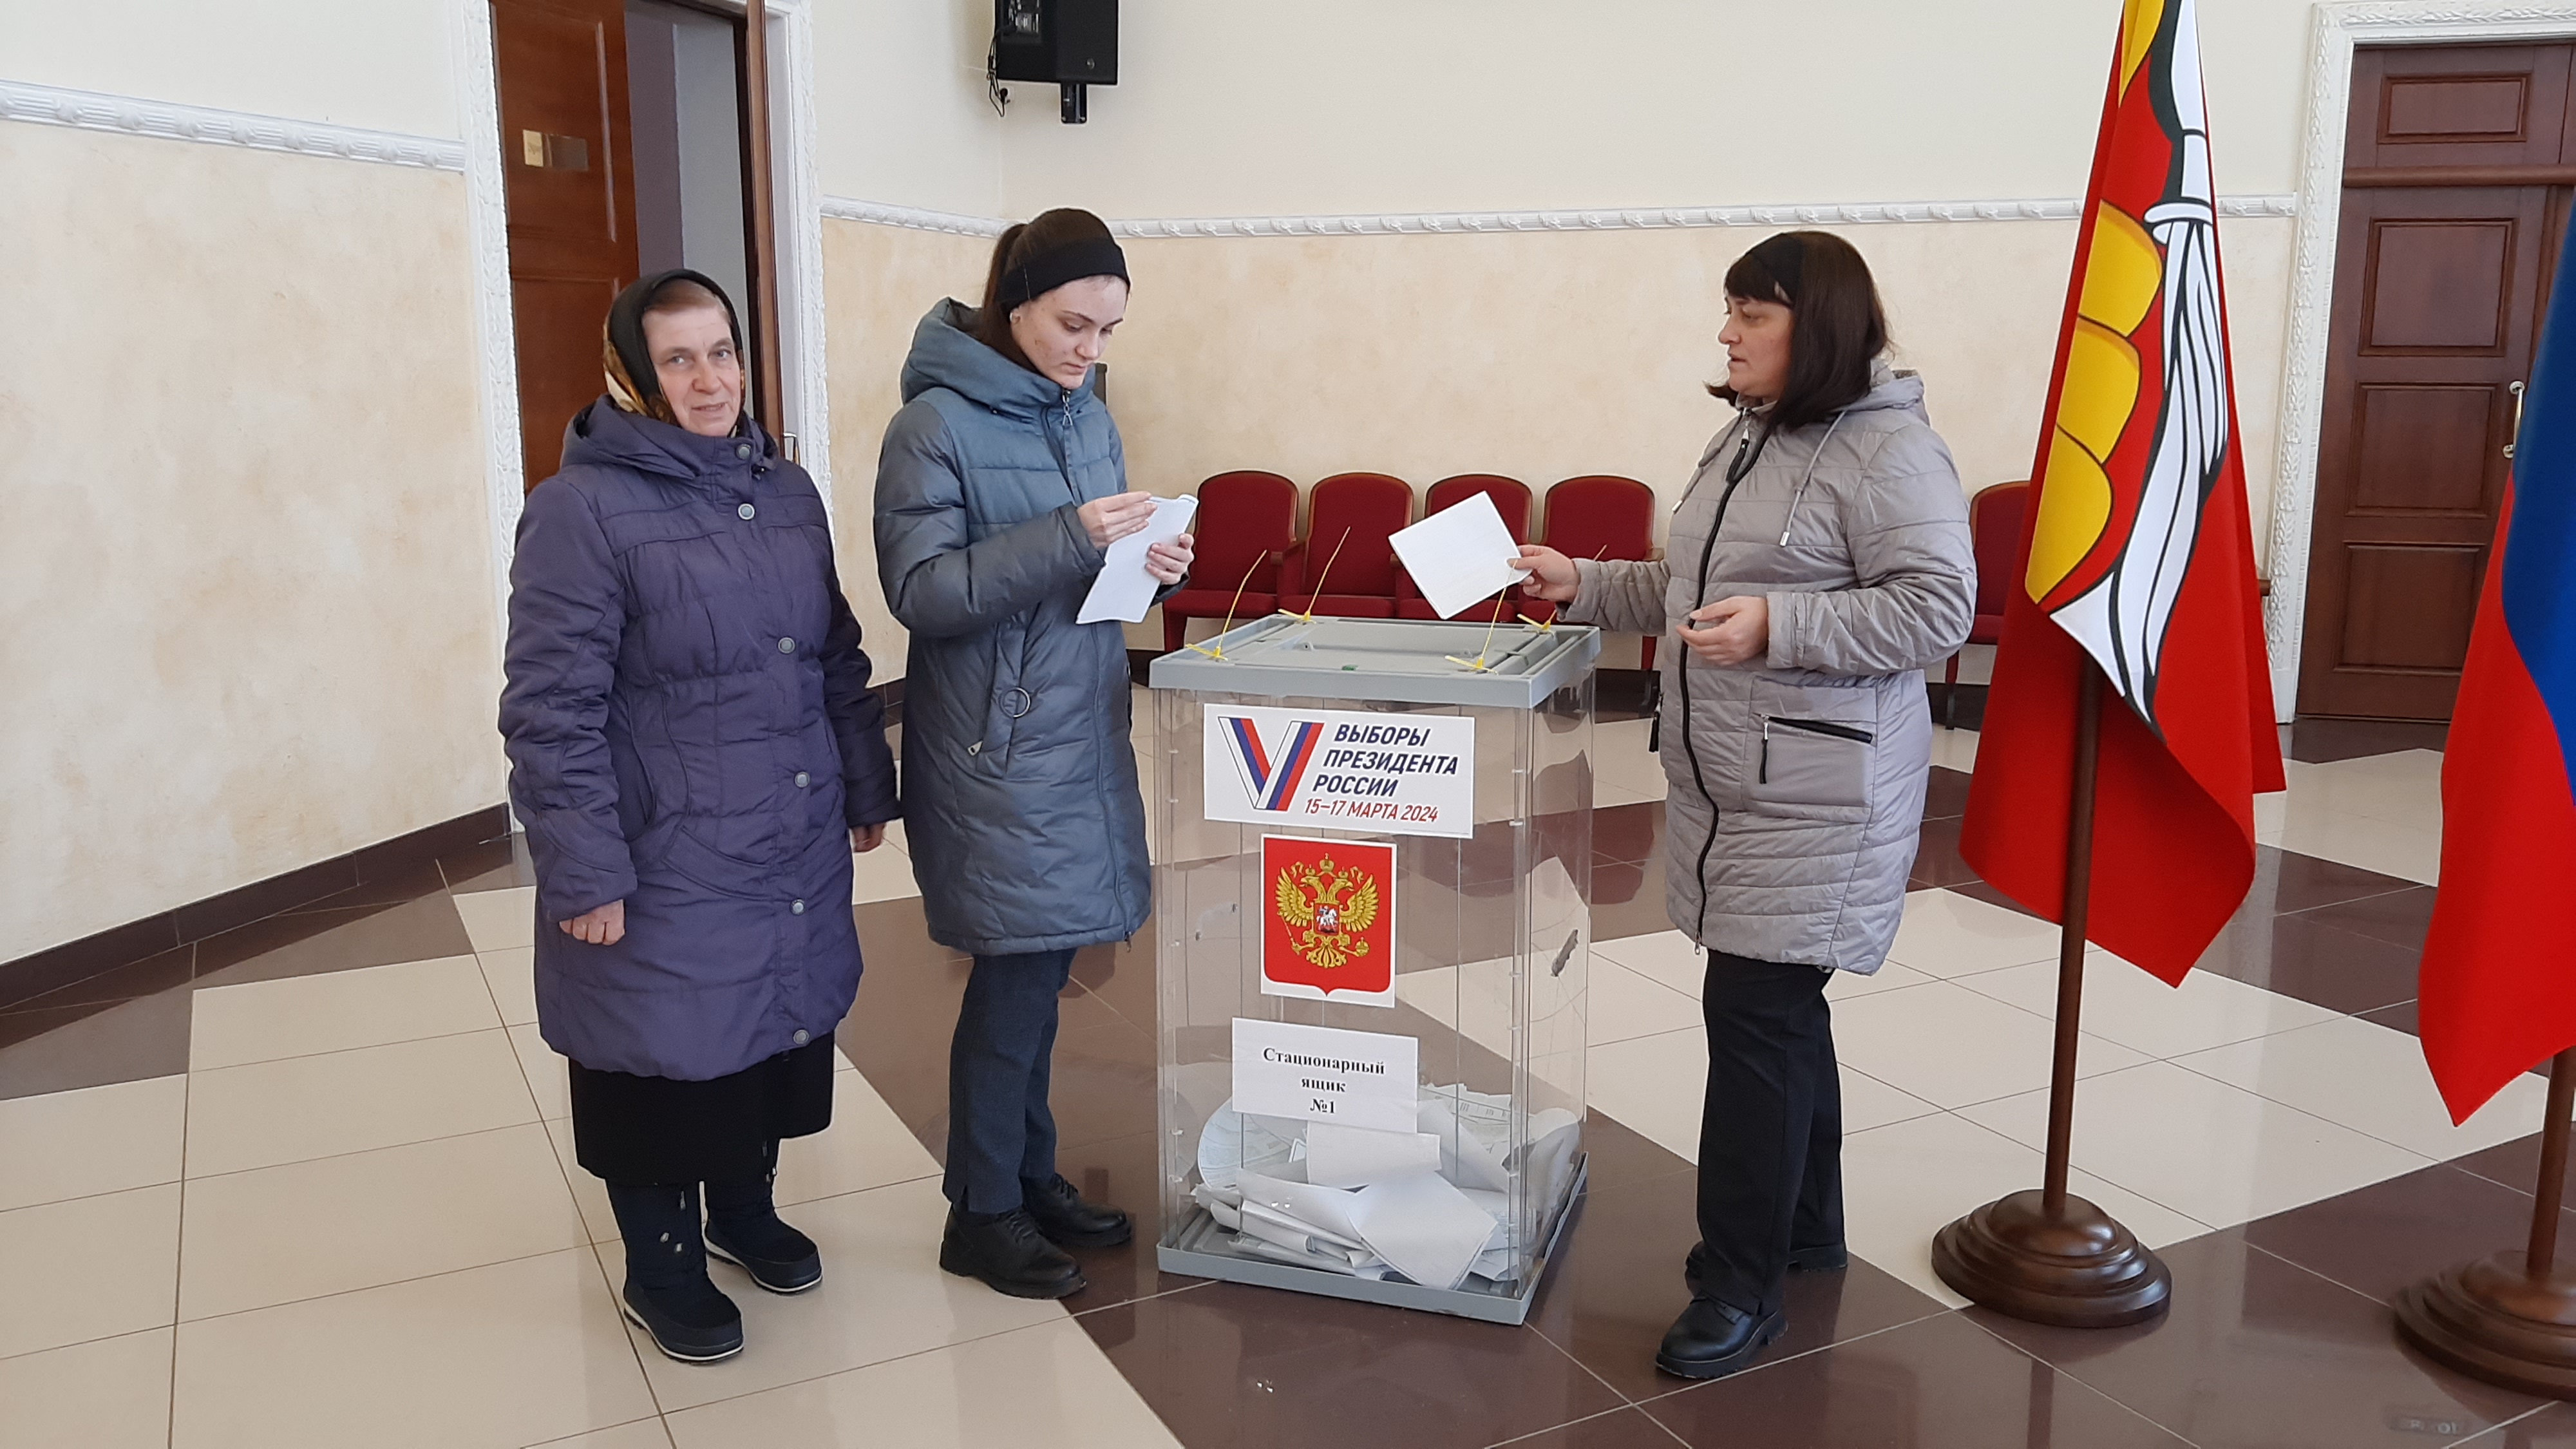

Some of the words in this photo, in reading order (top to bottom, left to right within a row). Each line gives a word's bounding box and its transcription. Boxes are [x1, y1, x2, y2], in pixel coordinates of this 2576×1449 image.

[1334, 724, 1430, 746] ВЫБОРЫ
[1323, 749, 1458, 774] ПРЕЗИДЕНТА
[1312, 774, 1398, 797] РОССИИ
[1347, 801, 1397, 819] МАРТА
[1401, 804, 1438, 822] 2024
[1263, 1047, 1385, 1074] Стационарный
[1301, 1077, 1346, 1092] ящик
[1309, 1098, 1335, 1113] №1
